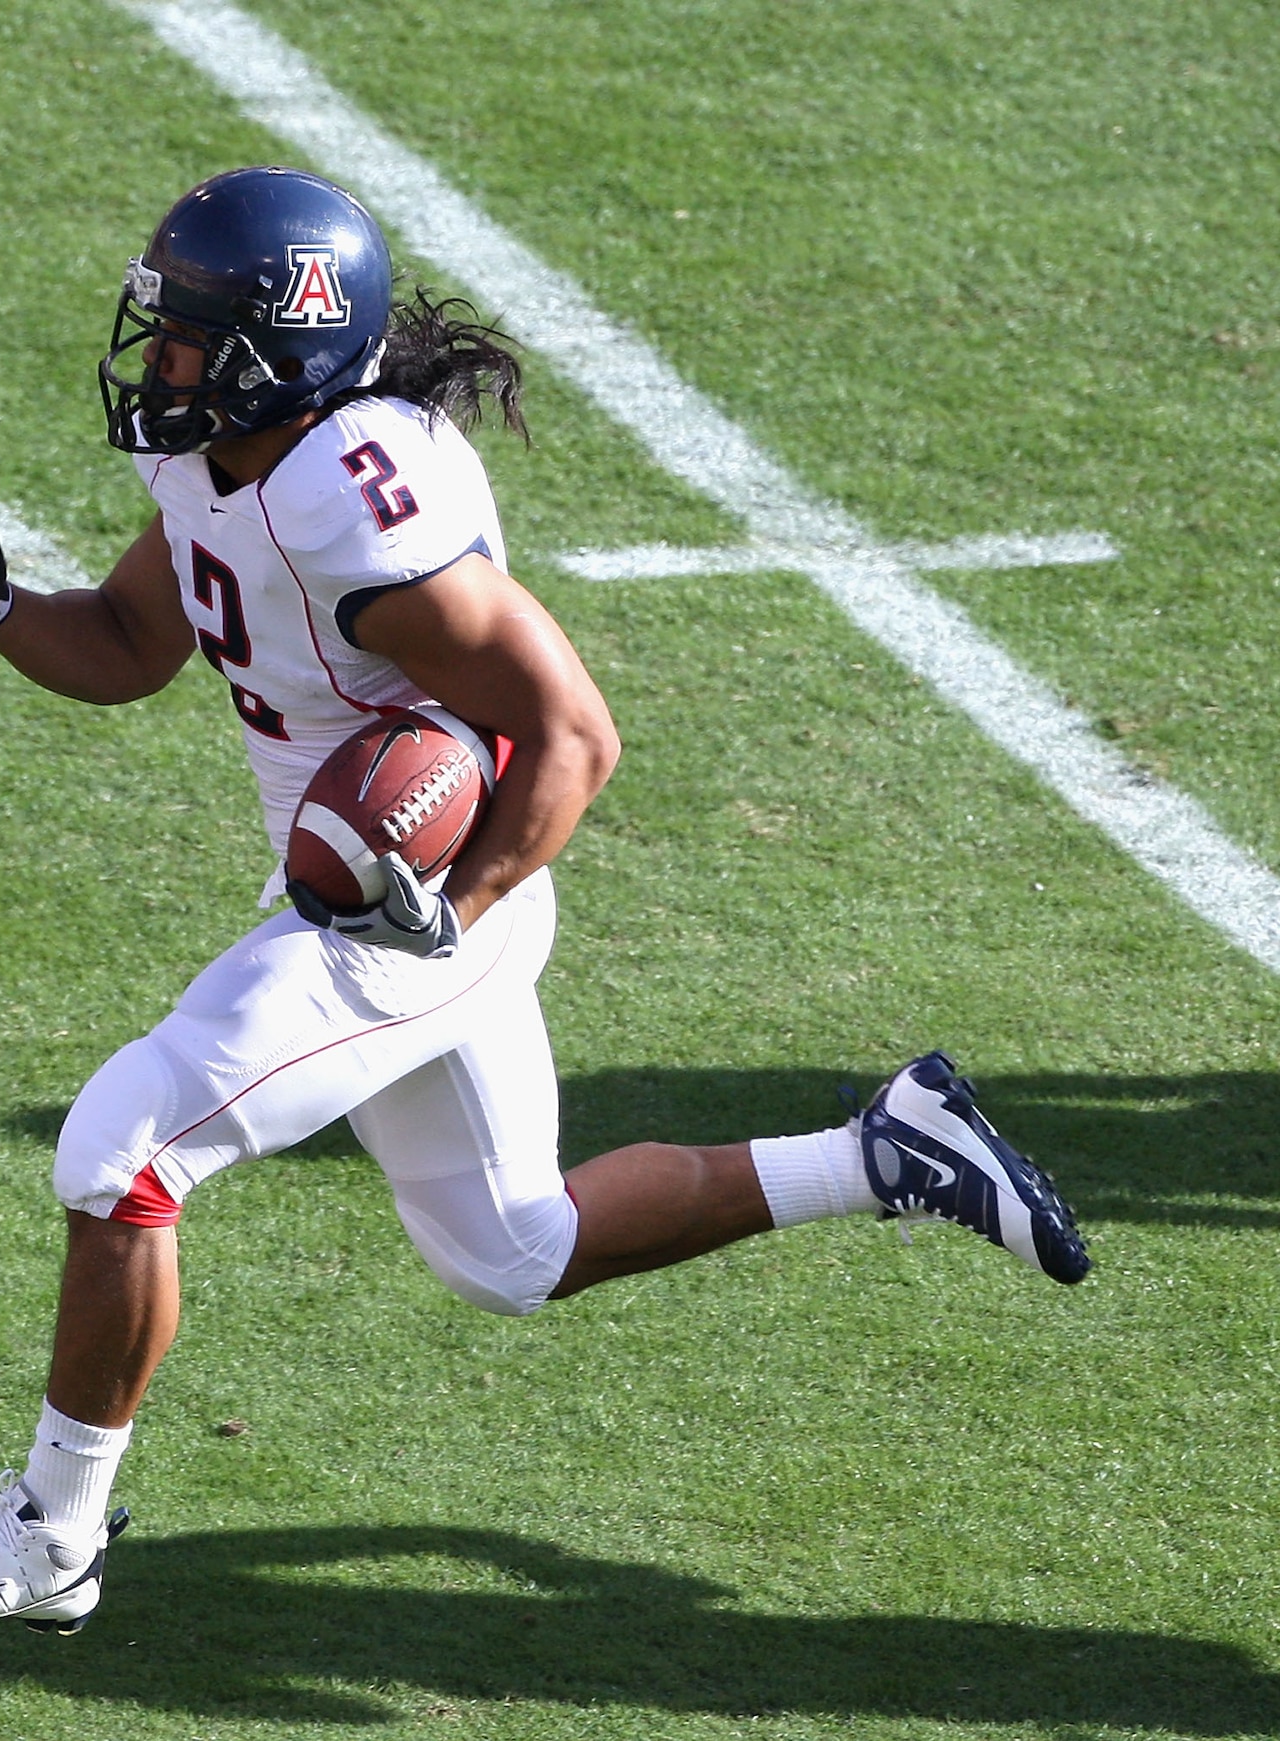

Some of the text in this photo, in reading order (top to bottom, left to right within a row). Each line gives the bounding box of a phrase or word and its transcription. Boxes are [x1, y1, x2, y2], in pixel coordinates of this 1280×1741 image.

[272, 244, 351, 328] A
[208, 336, 237, 381] Riddell
[339, 440, 420, 532] 2
[191, 539, 291, 741] 2
